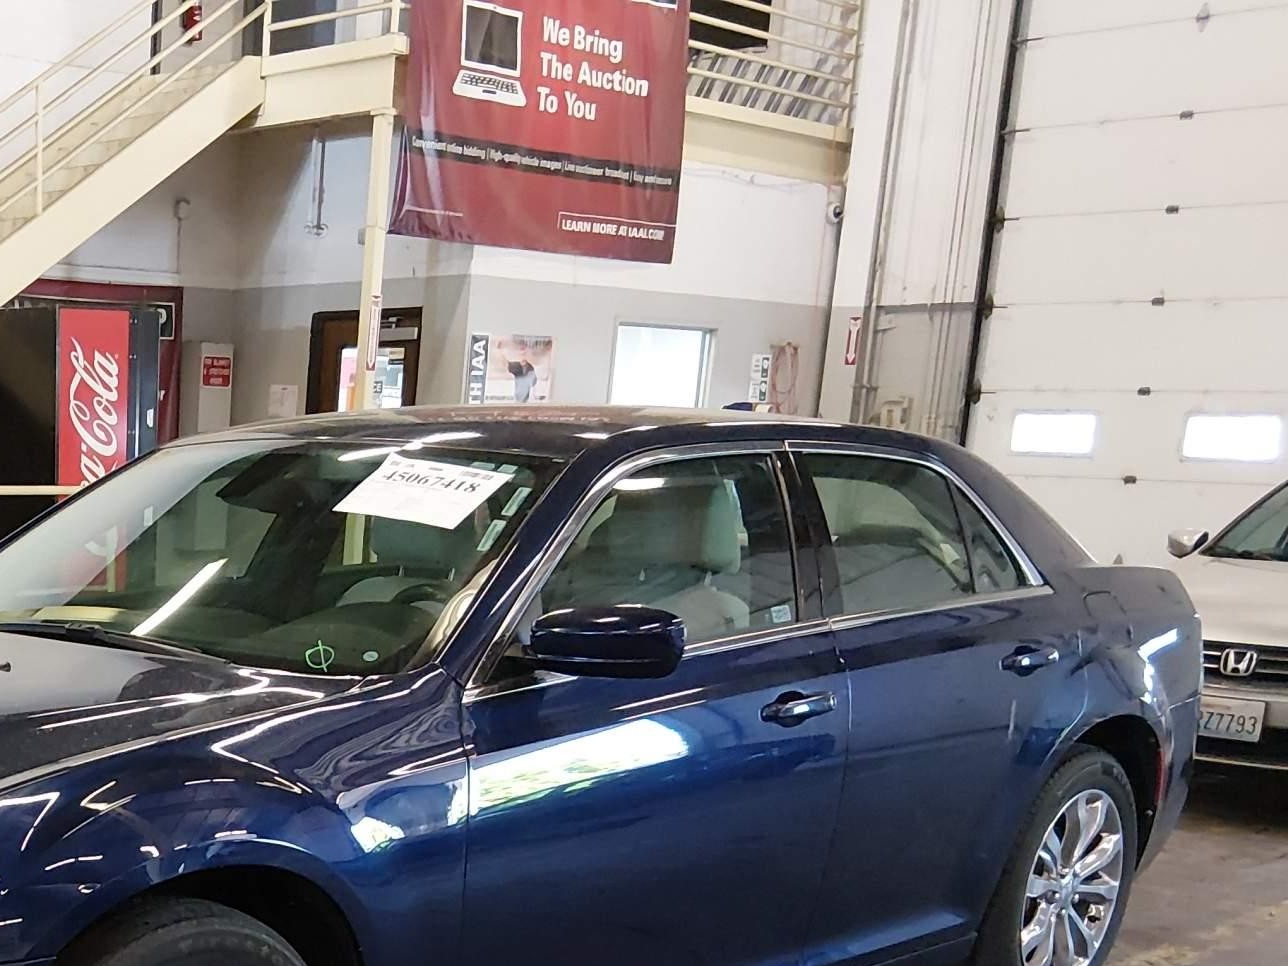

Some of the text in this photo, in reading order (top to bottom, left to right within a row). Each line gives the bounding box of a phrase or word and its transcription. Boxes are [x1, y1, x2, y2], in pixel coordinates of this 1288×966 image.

[543, 16, 623, 63] We Bring
[540, 51, 649, 97] The Auction
[537, 86, 597, 120] To You
[562, 219, 592, 233] LEARN
[592, 222, 618, 236] MORE
[618, 226, 628, 236] AT
[471, 340, 486, 376] IAA
[382, 470, 481, 493] 45067418
